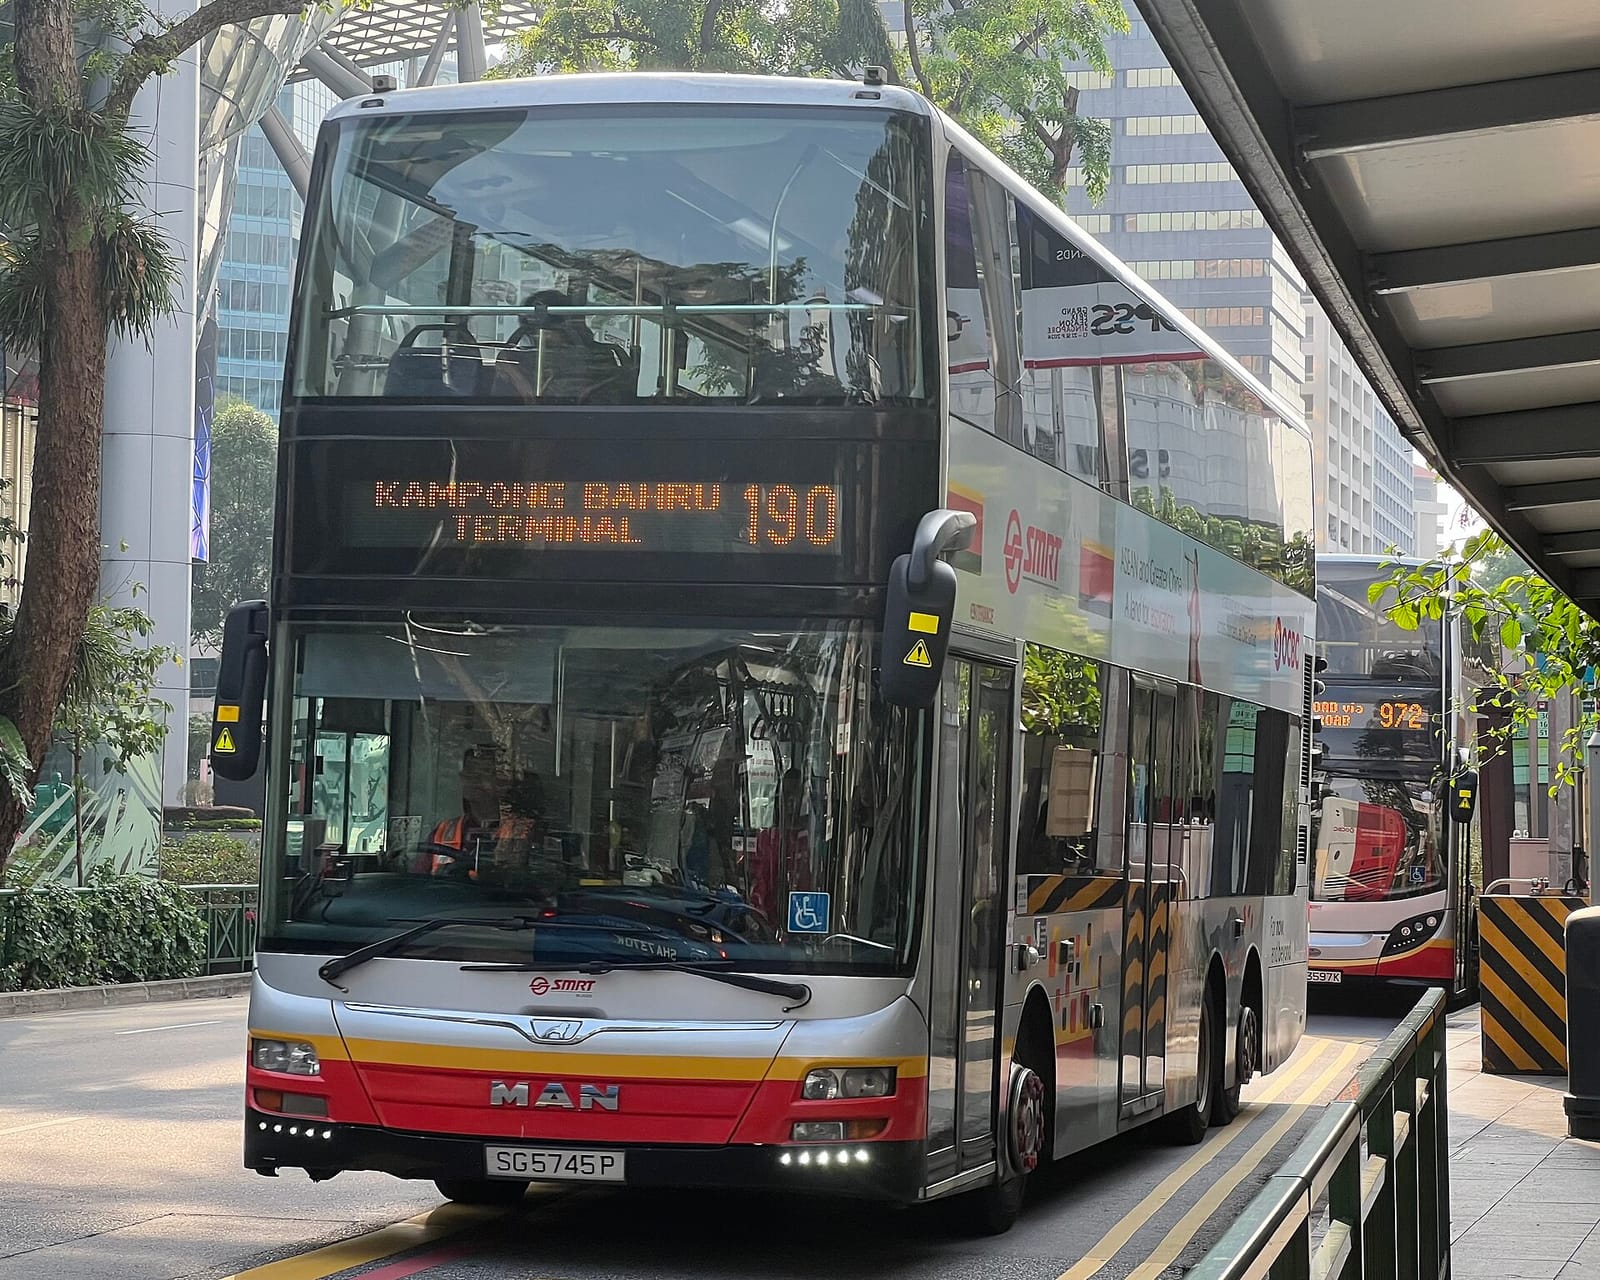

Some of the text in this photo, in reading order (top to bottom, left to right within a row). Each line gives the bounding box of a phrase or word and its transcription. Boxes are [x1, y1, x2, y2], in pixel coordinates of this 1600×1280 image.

[375, 481, 721, 510] KAMPONG BAHRU
[743, 484, 837, 545] 190
[452, 515, 642, 543] TERMINAL
[1023, 526, 1062, 582] SMRT
[1281, 626, 1300, 671] OCBC
[1380, 702, 1423, 729] 972
[551, 979, 596, 991] SMRT
[1307, 971, 1340, 982] 3597K
[490, 1080, 620, 1111] MAN
[496, 1152, 615, 1176] SG5745P
